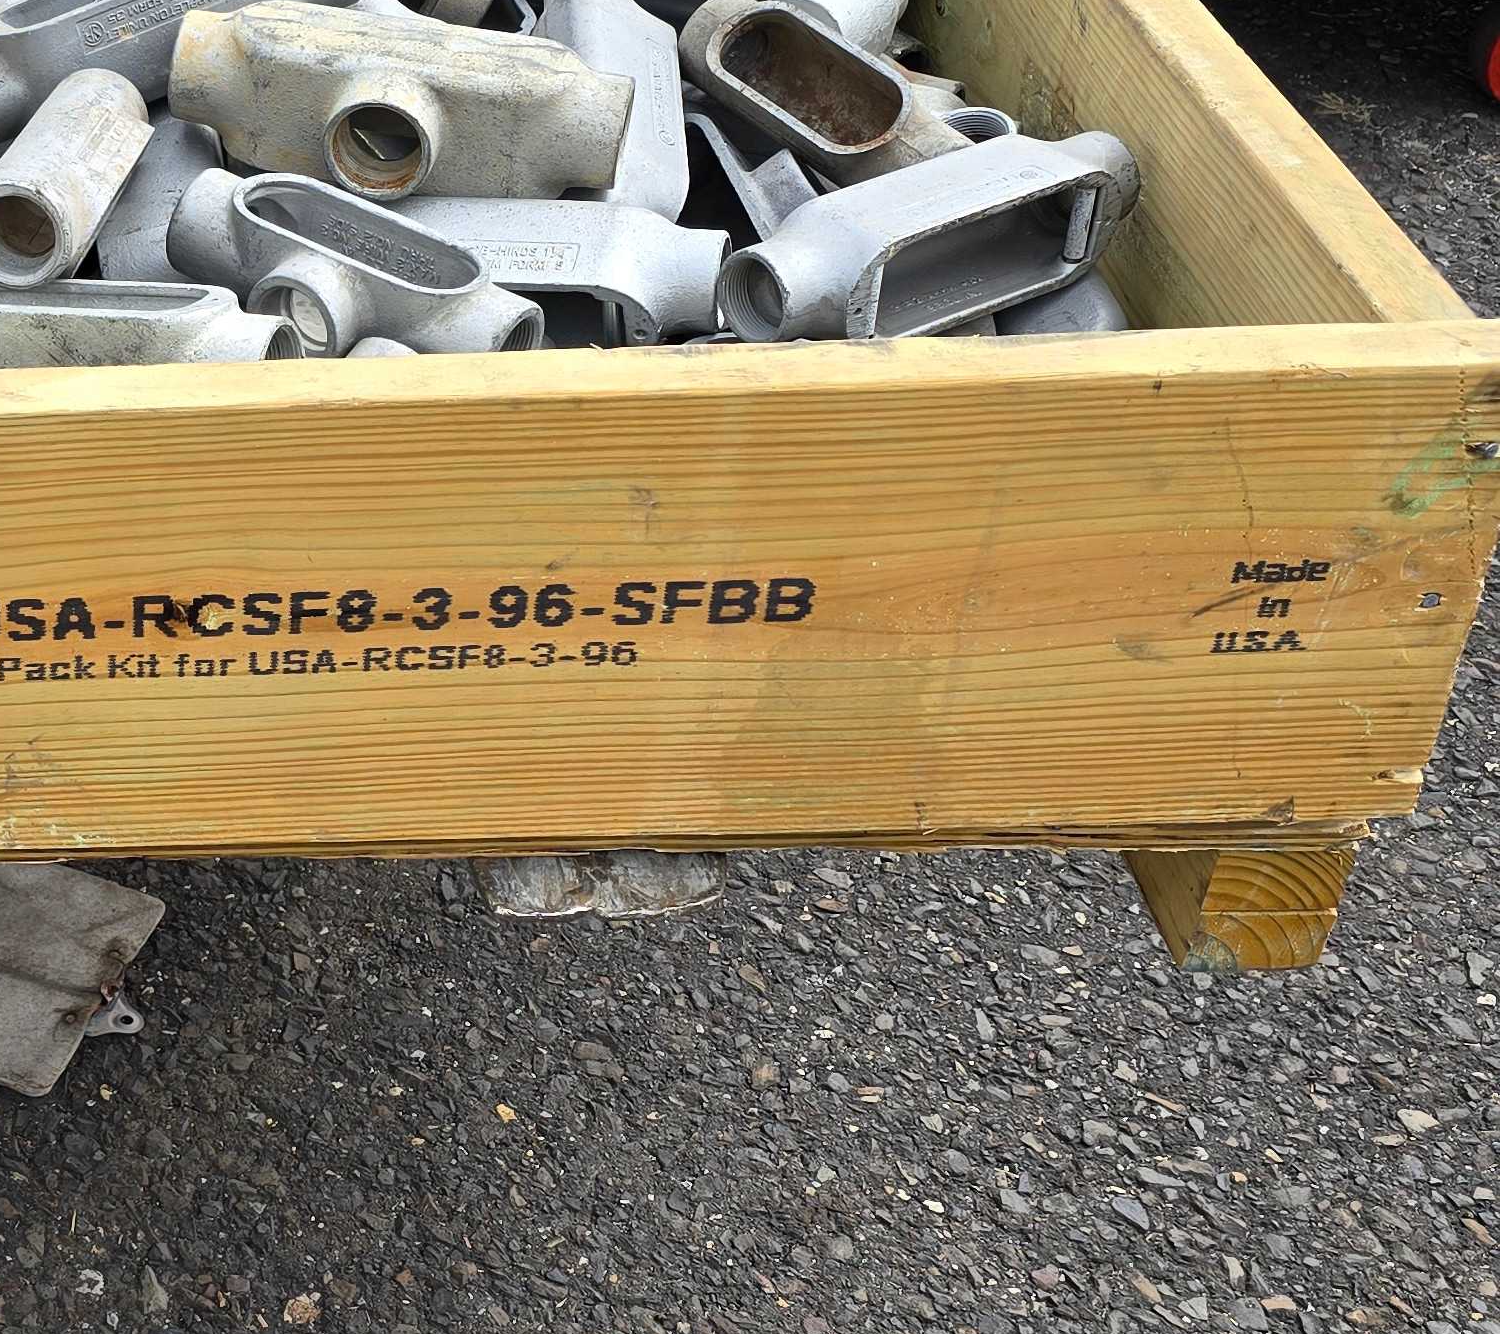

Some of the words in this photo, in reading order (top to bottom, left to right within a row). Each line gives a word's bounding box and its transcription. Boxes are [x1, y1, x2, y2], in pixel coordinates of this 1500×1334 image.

[1230, 559, 1331, 584] Made
[1256, 596, 1292, 618] in
[107, 652, 162, 679] Kit
[173, 653, 237, 678] for
[247, 640, 639, 676] USA-RCSF8-3-96
